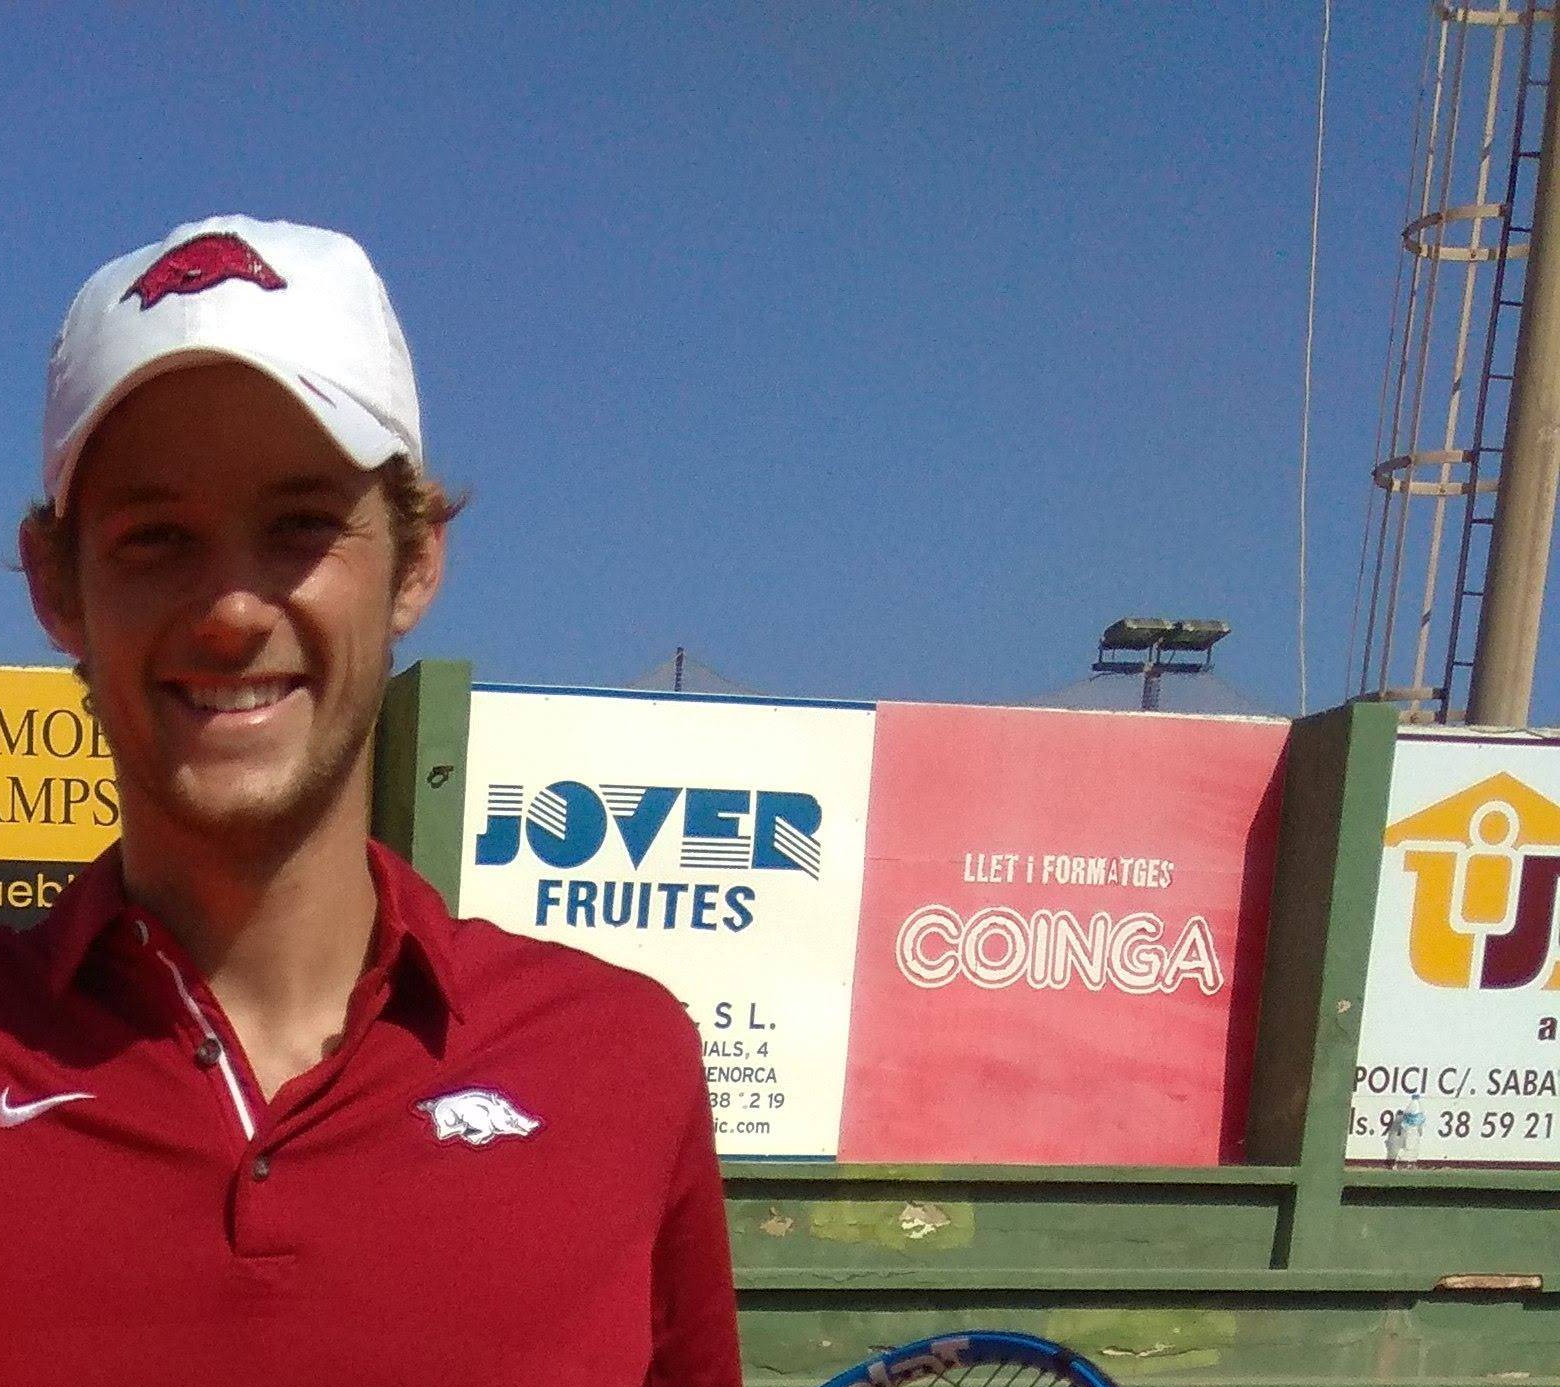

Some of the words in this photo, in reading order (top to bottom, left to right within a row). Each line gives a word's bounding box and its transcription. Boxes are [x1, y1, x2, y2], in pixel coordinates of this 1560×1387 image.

[476, 780, 821, 880] JOVER
[964, 853, 1016, 884] LLET
[1042, 855, 1174, 888] FORMATGES
[535, 879, 757, 933] FRUITES
[895, 904, 1224, 997] COINGA
[757, 1042, 768, 1057] 4
[705, 1067, 777, 1083] ENORCA
[1354, 1066, 1428, 1094] POICI
[768, 1093, 785, 1109] 19
[1438, 1110, 1471, 1138] 38
[1480, 1111, 1515, 1139] 59
[1525, 1112, 1553, 1139] 21
